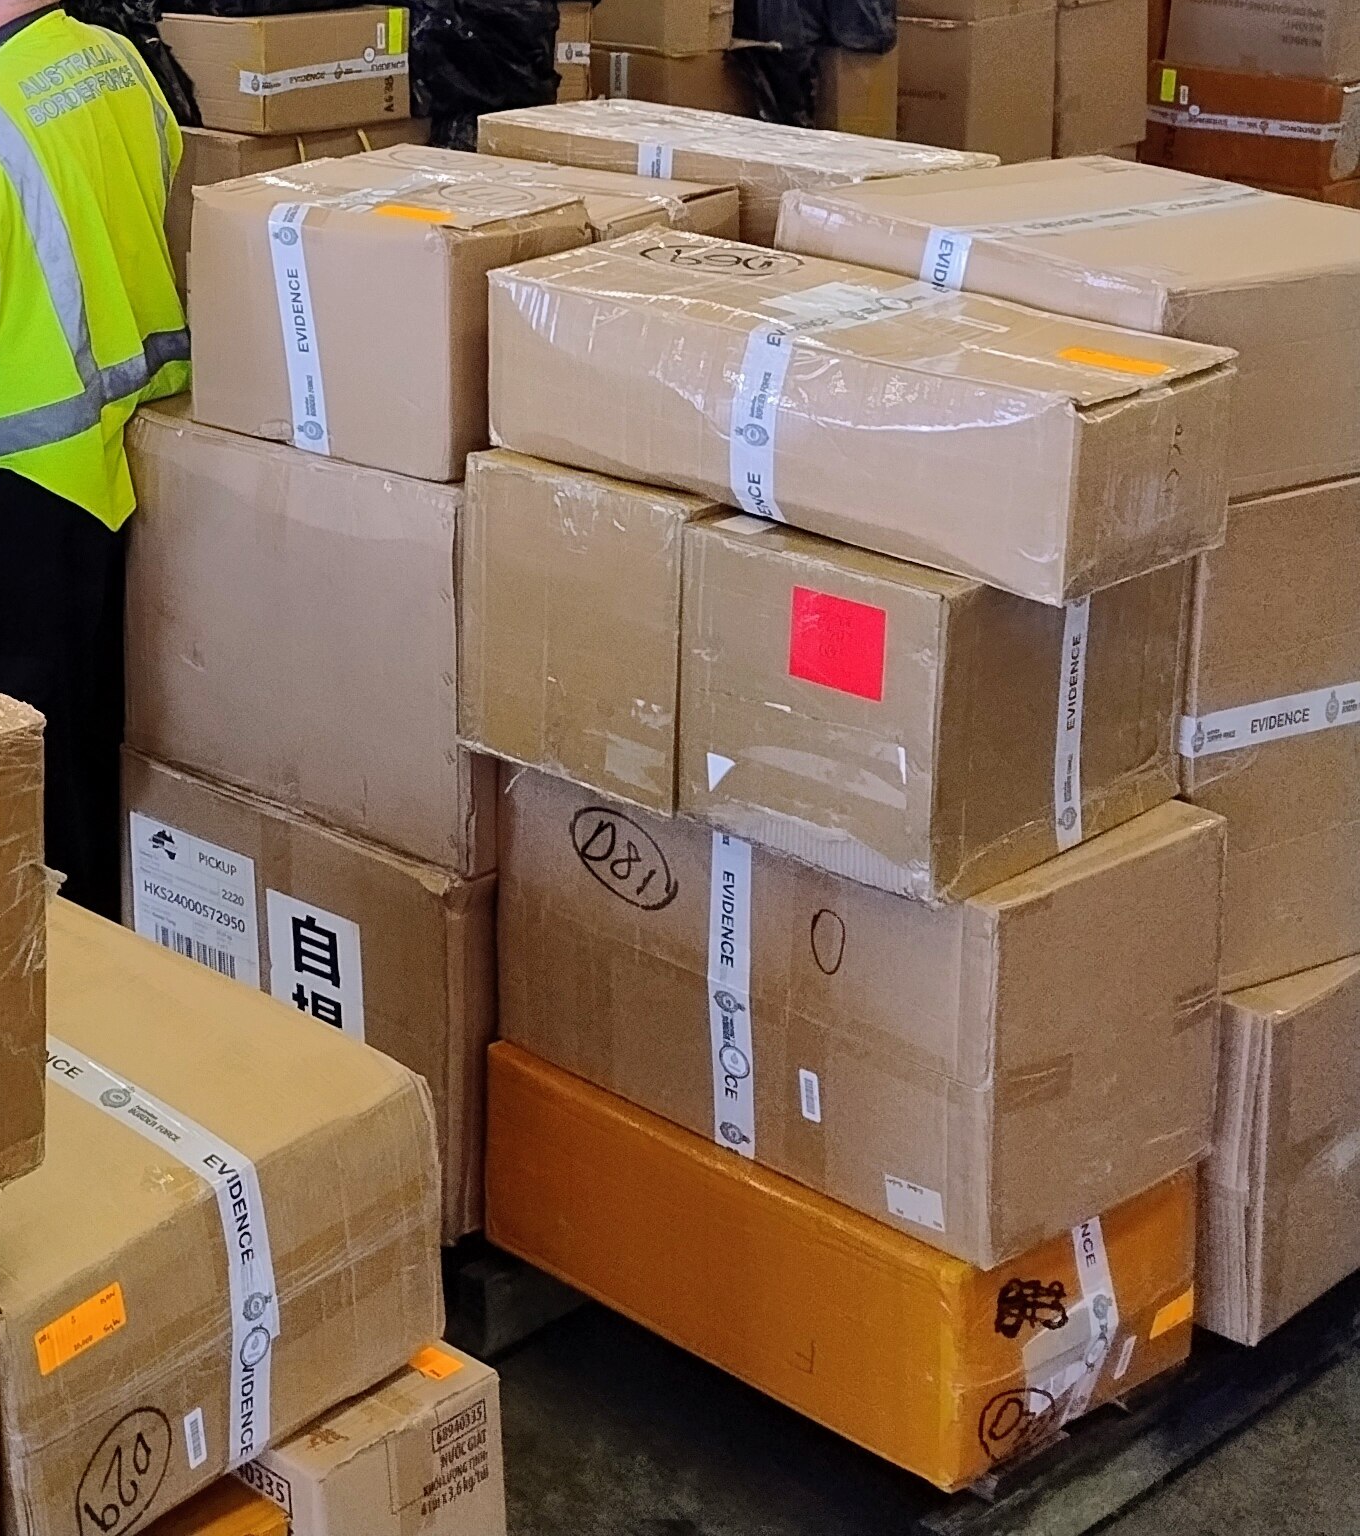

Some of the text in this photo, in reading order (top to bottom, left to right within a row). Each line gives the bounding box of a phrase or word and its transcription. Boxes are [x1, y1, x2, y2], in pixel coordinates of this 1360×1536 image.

[24, 76, 100, 127] BORDER
[287, 267, 310, 353] EVIDENCE
[1066, 633, 1081, 732] EVIDENCE
[1250, 707, 1310, 734] EVIDENCE
[198, 852, 237, 877] PICKUP
[221, 888, 245, 907] 2220
[143, 879, 246, 934] HKS24000572950
[719, 870, 736, 969] EVIDENCE
[202, 1153, 255, 1266] EVIDENCE
[239, 1364, 255, 1458] VIDENCE
